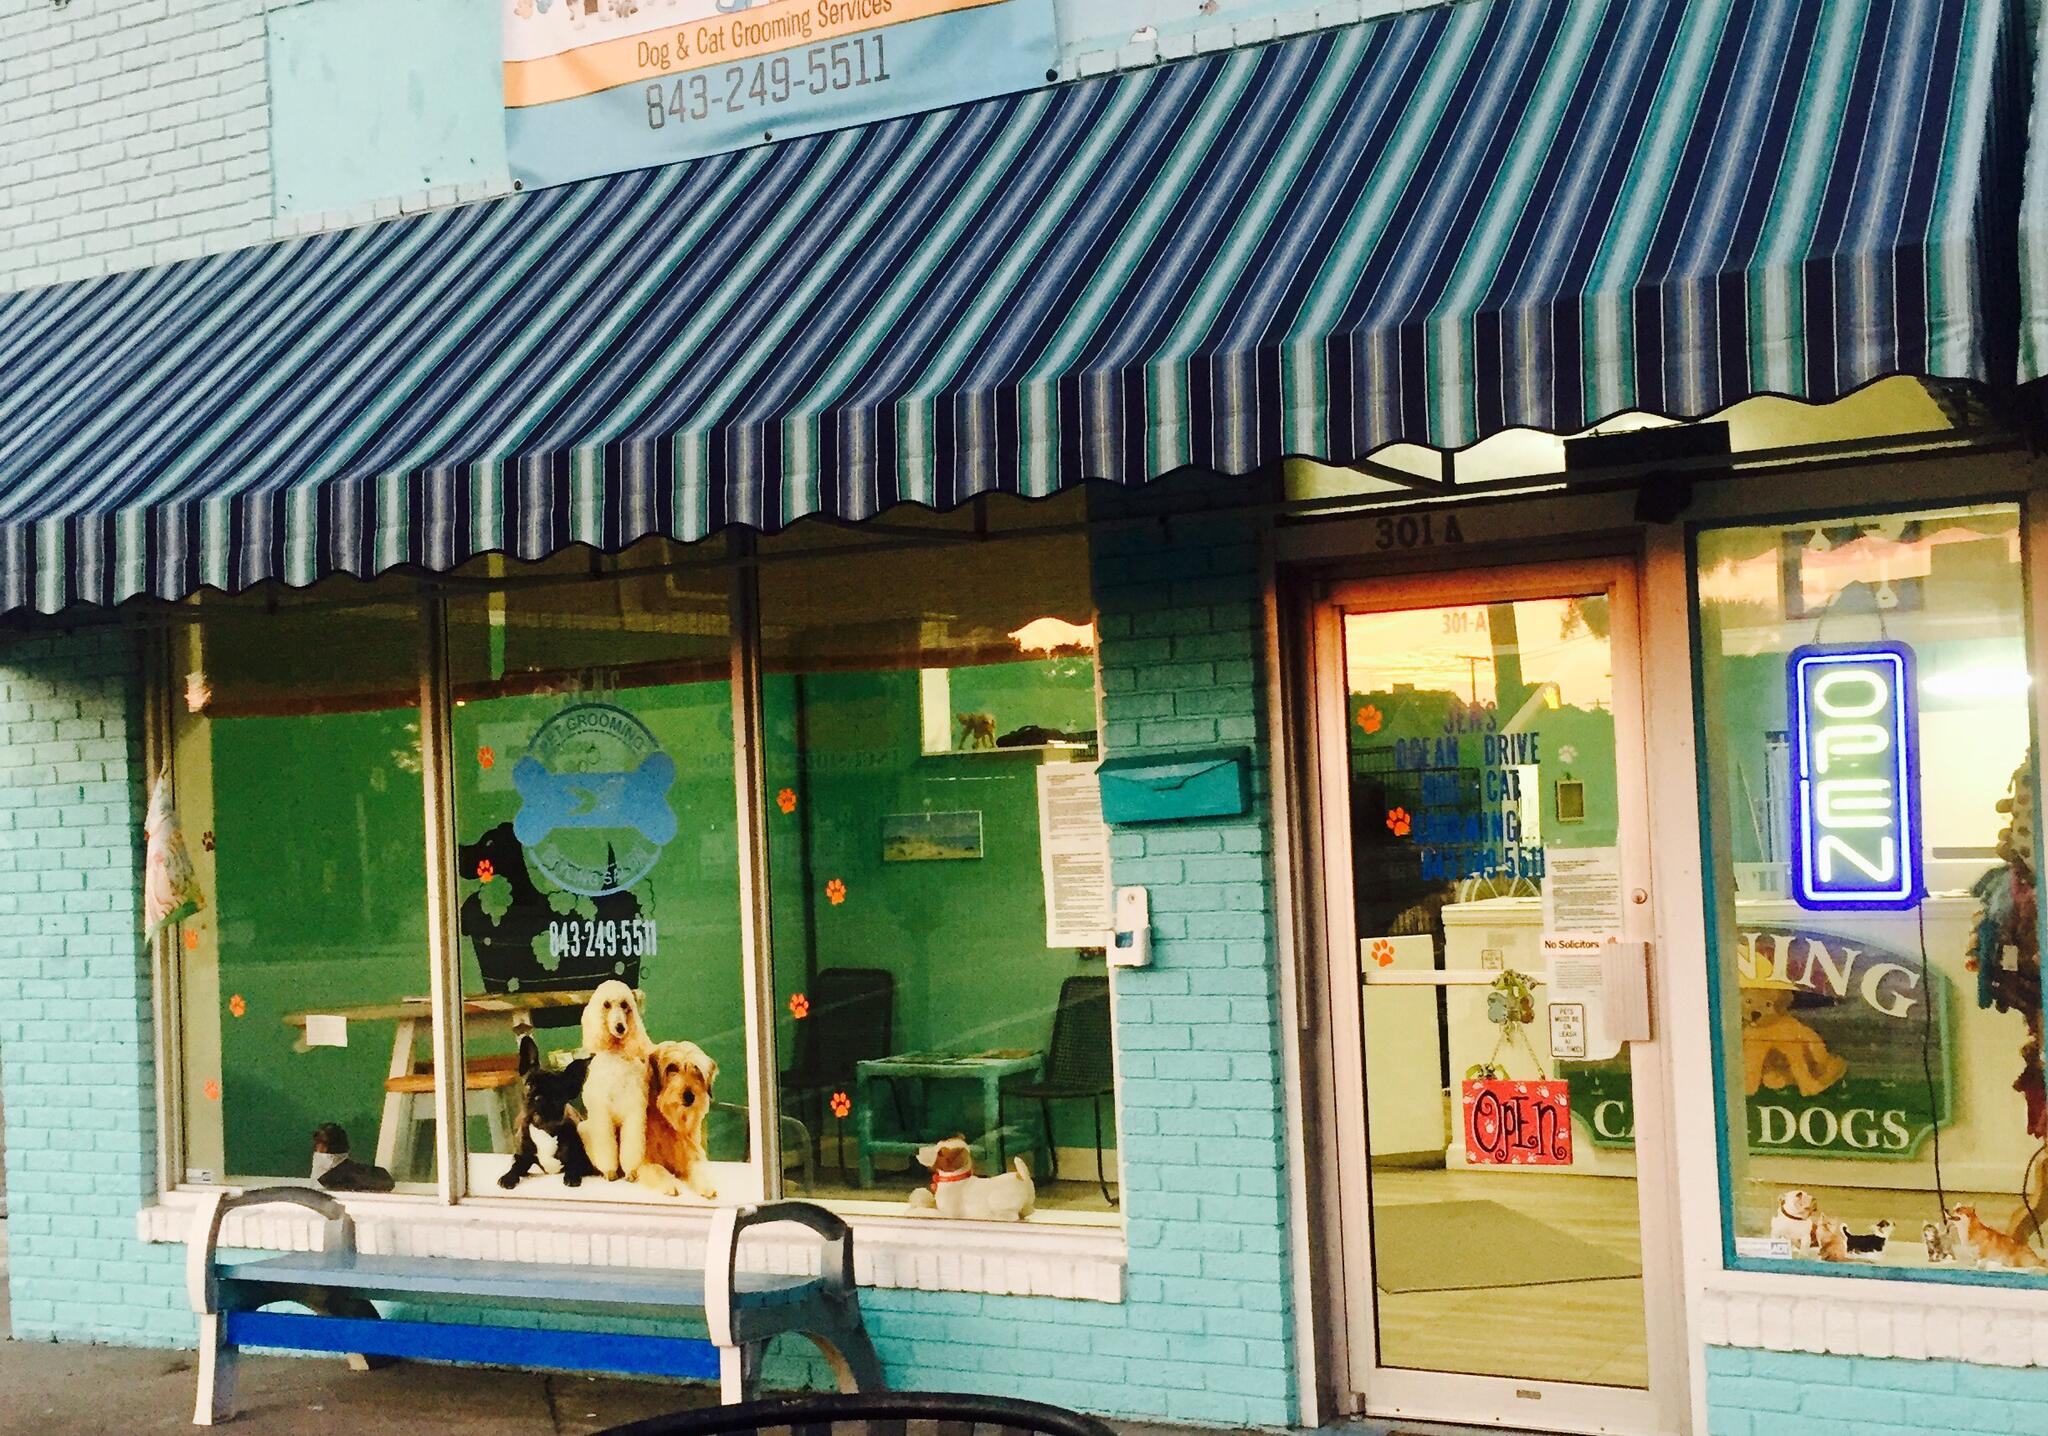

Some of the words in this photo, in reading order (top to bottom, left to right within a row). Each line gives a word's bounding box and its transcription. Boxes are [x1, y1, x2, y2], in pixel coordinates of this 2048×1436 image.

[638, 41, 671, 70] Dog
[677, 32, 689, 60] &
[697, 26, 725, 54] Cat
[732, 9, 812, 48] Grooming
[817, 0, 892, 28] Services
[645, 34, 891, 130] 843-249-5511
[1442, 611, 1487, 634] 301-A
[566, 712, 646, 750] GROOMING
[1484, 732, 1541, 766] DRIVE
[1486, 769, 1522, 802] CAT
[1813, 669, 1894, 883] OPEN
[1545, 940, 1557, 949] No
[1559, 939, 1600, 949] Solicitors
[1757, 1105, 1909, 1149] DOGS
